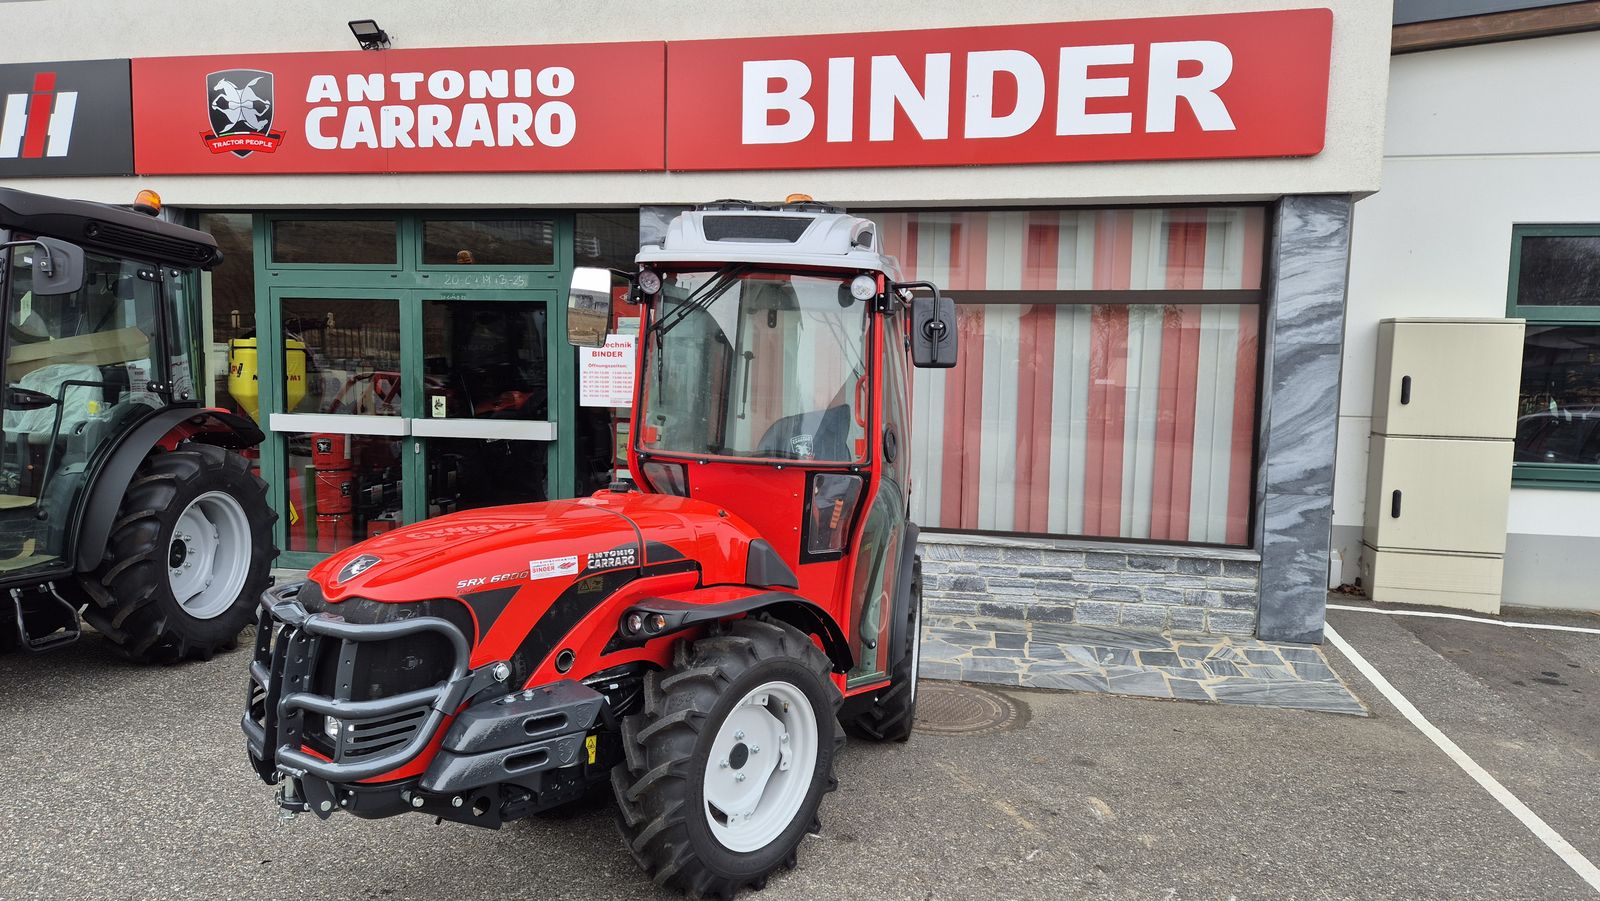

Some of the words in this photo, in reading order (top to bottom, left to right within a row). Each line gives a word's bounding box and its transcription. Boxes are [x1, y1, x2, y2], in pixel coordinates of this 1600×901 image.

[305, 66, 575, 103] ANTONIO
[741, 40, 1236, 145] BINDER
[304, 100, 577, 150] CARRARO
[212, 139, 244, 149] TRACTOR
[245, 139, 273, 148] PEOPLE
[591, 350, 623, 358] BINDER
[587, 548, 635, 560] ANTONIO
[587, 555, 635, 569] CARRARO
[456, 576, 487, 589] SRX
